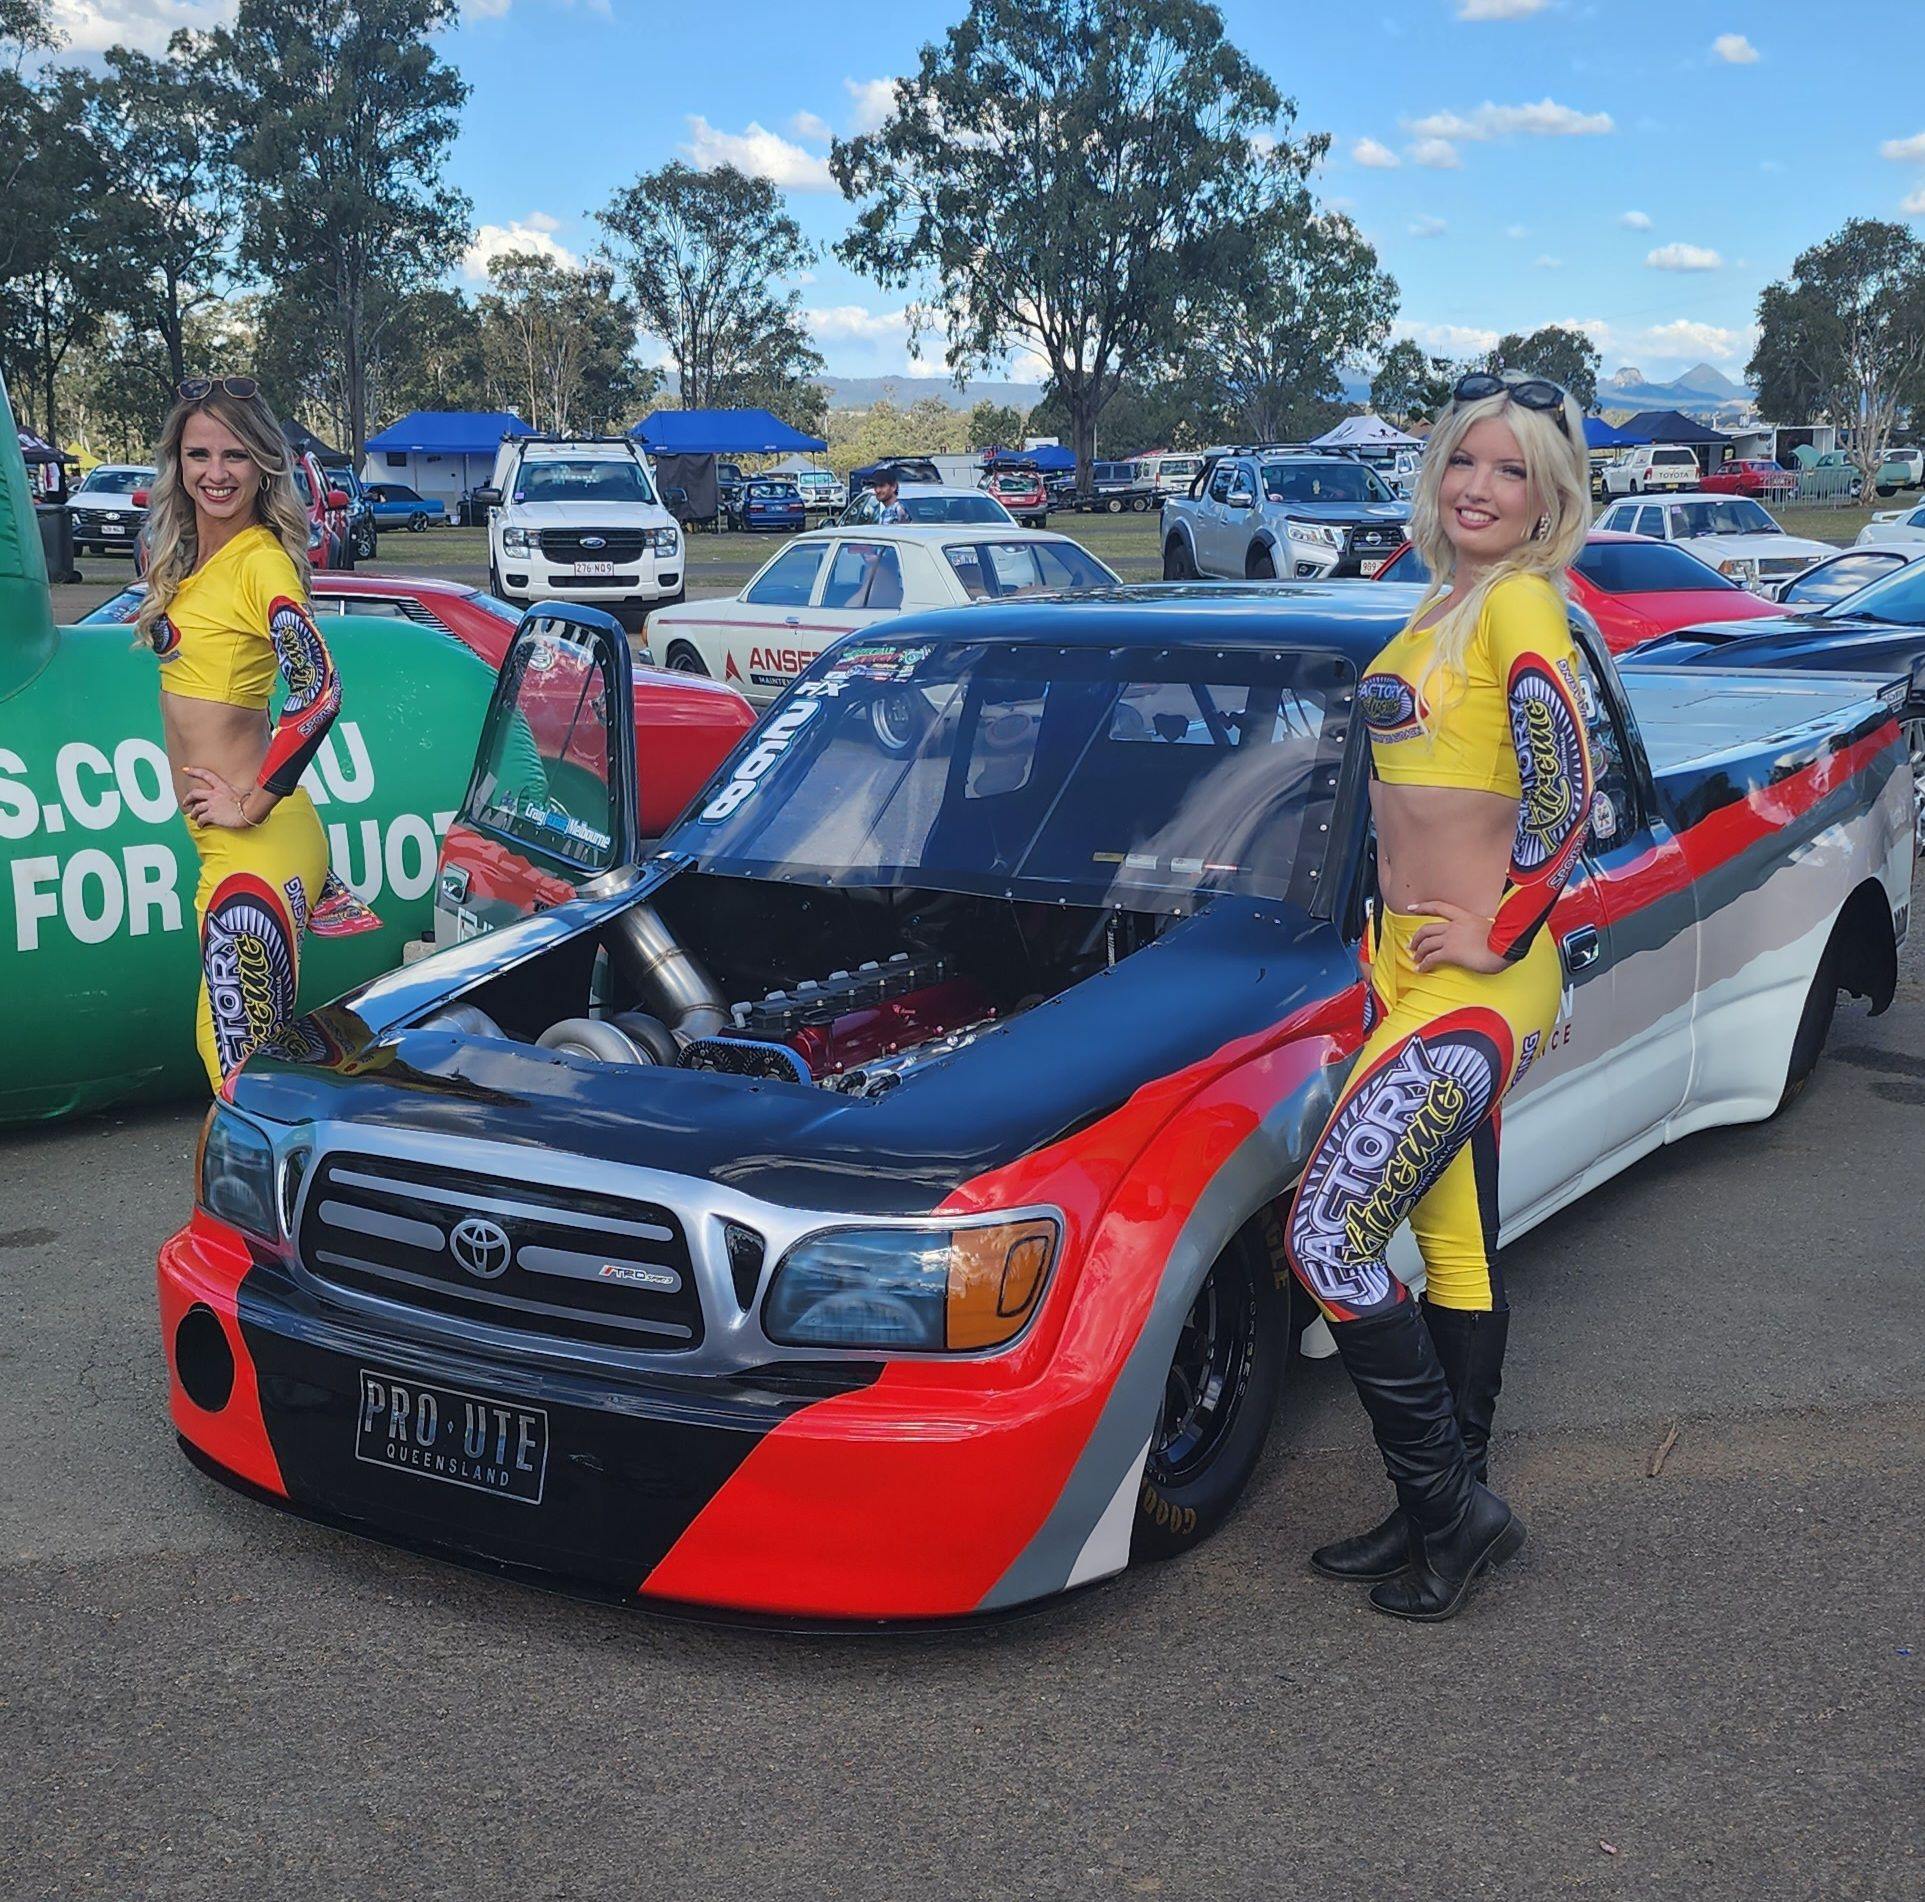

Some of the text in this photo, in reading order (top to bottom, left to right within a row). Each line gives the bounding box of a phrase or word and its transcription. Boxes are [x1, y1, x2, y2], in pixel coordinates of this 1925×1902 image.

[576, 563, 592, 573] 276
[1559, 733, 1569, 776] AUSTRALIA
[525, 803, 546, 826] Craig
[568, 816, 611, 849] Melbourne
[1548, 847, 1583, 889] SPORT
[10, 843, 183, 952] FOR
[1301, 1035, 1451, 1300] FACTORY
[1414, 1144, 1454, 1197] AUSTRALIA
[364, 1380, 536, 1472] PRO UTE
[386, 1443, 510, 1487] QUEENSLAND
